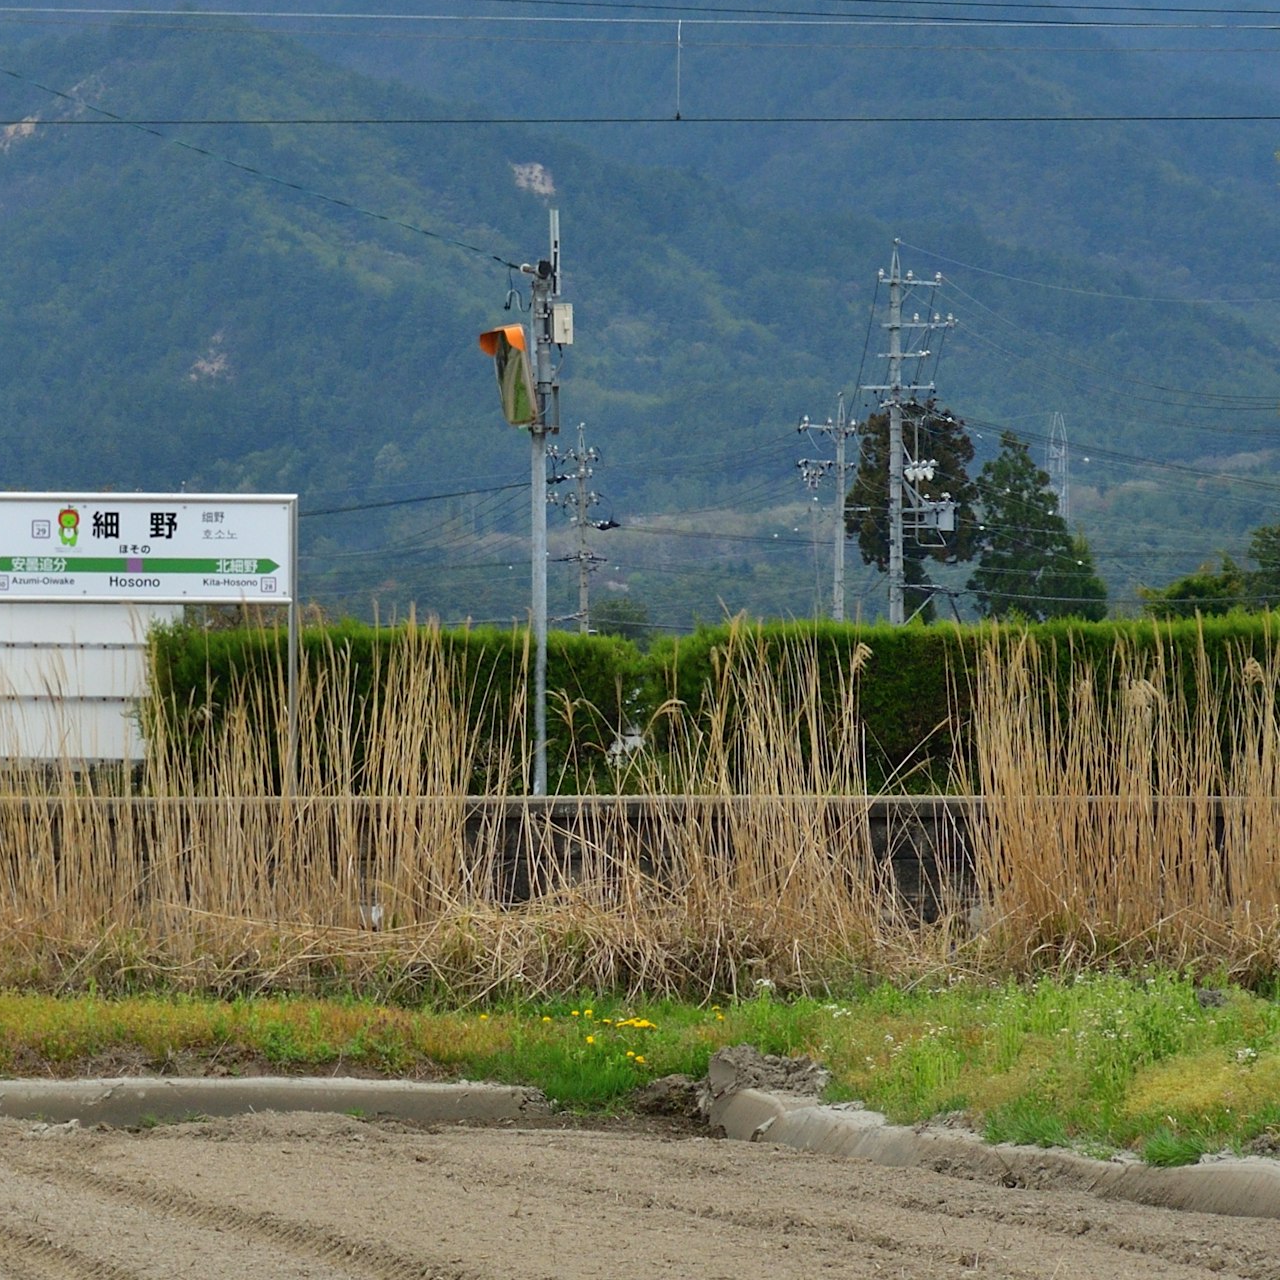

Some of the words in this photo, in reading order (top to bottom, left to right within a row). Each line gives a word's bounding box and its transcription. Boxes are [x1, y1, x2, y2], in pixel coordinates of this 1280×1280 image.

[36, 527, 46, 536] 29
[202, 529, 238, 540] 호소노
[119, 544, 151, 554] ほその
[11, 558, 67, 572] 安曇追分
[216, 559, 258, 573] 北細野
[12, 577, 75, 586] Azumi-Oiwake
[109, 576, 160, 588] Hosono
[203, 578, 258, 587] Kita-Hosono
